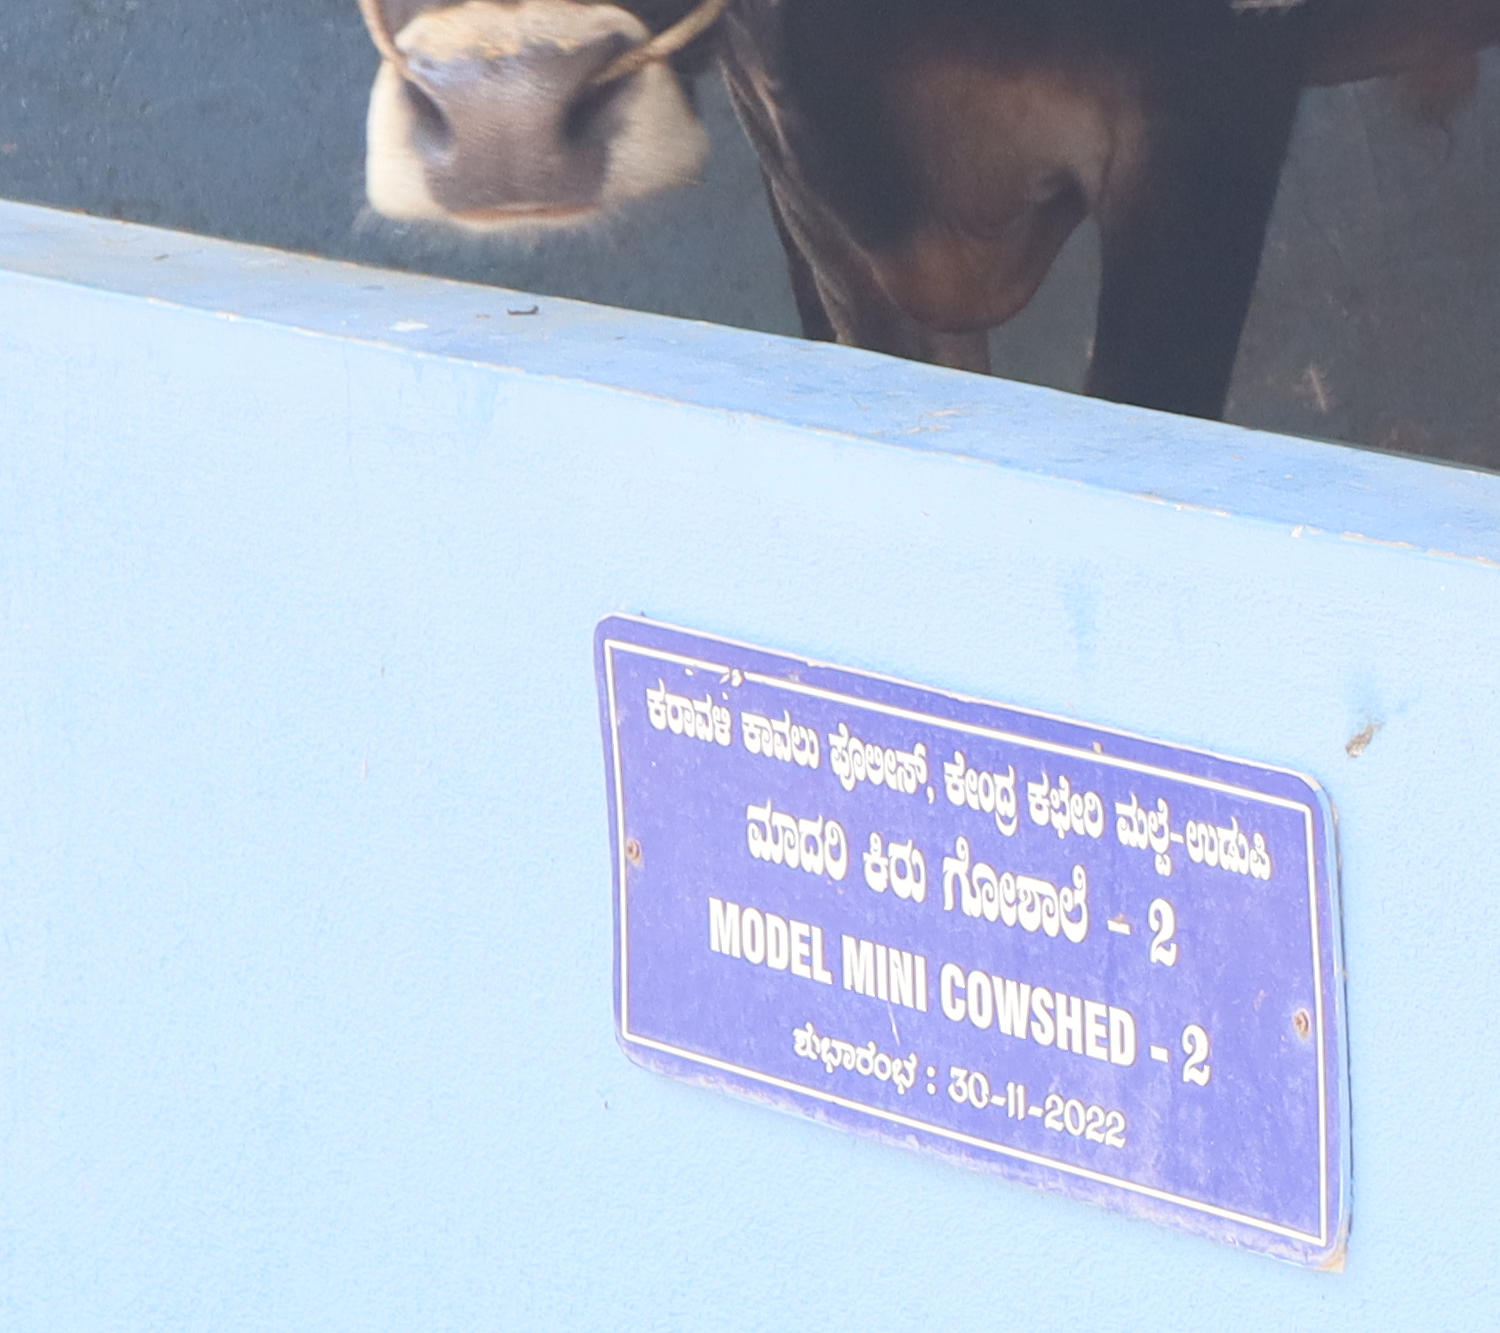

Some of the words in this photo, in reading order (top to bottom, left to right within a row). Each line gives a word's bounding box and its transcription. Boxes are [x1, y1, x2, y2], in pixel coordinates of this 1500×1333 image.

[645, 677, 732, 747] ಕರಾವಳಿ
[741, 709, 820, 770] ಕಾವಲು
[944, 750, 1018, 837] ಕೇಂದ್ರ
[746, 798, 849, 881] ಮಾದರಿ
[862, 832, 927, 904] ಕಿರು
[941, 836, 1090, 943] ಗೋಶಾಲೆ
[708, 897, 833, 985] MODEL
[841, 934, 928, 1013] MINI
[940, 962, 1137, 1067] COWSHED
[1182, 1024, 1212, 1086] 2
[792, 1021, 918, 1095] ಶುಭಾರಂಭ
[947, 1065, 1127, 1149] 30-11-2022
